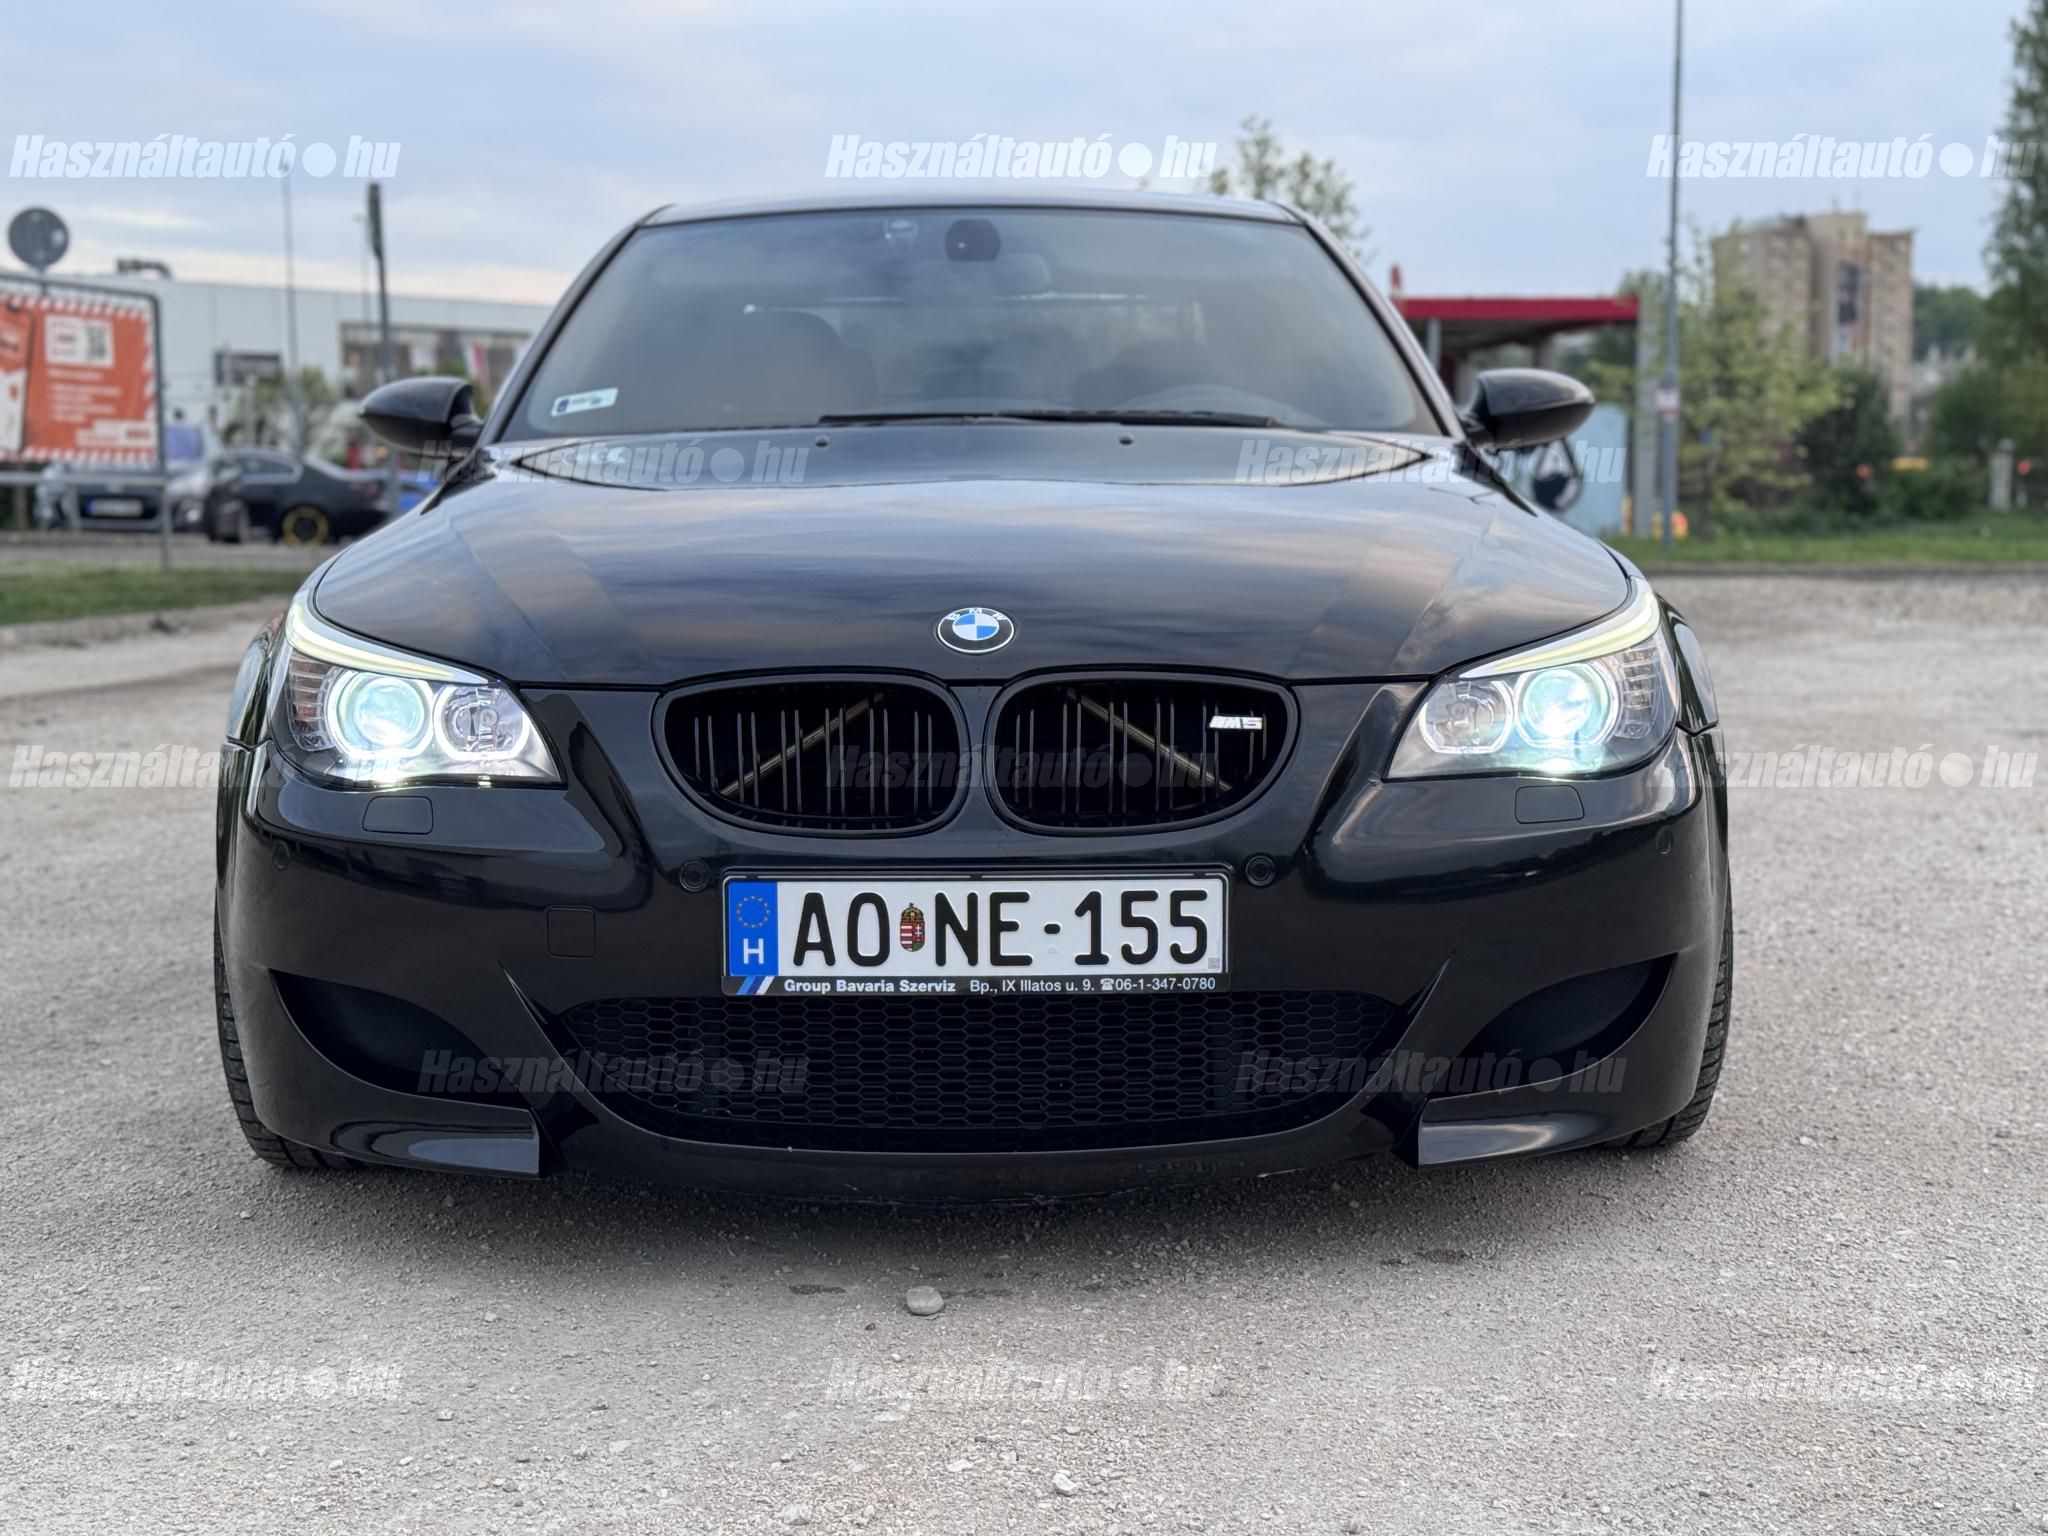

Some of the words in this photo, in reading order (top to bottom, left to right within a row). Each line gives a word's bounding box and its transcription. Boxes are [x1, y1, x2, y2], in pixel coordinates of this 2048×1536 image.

[743, 938, 765, 965] H
[784, 979, 831, 994] Group
[836, 979, 895, 993] Bavaria
[900, 979, 956, 993] Szerviz
[969, 979, 998, 995] Bp.,
[1002, 979, 1016, 992] IX
[1020, 979, 1062, 992] Illatos
[1066, 981, 1078, 992] u.
[1082, 979, 1095, 992] 9.
[1115, 977, 1216, 991] 06-1-347-0780
